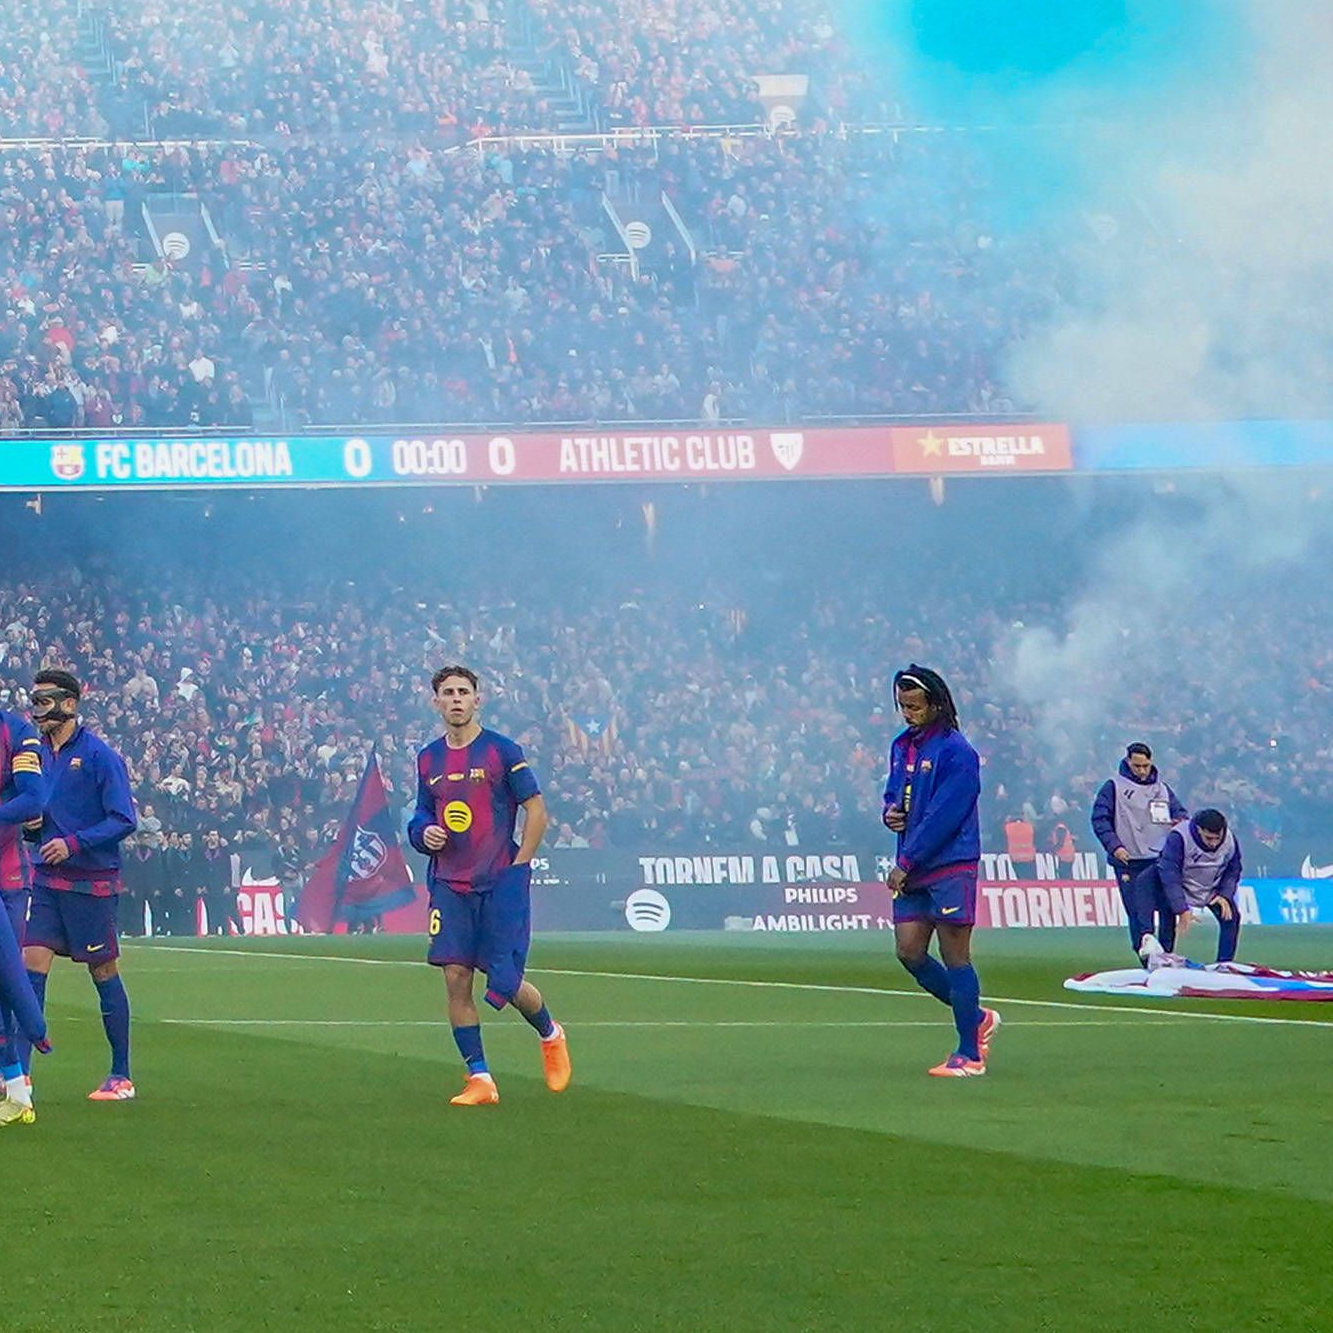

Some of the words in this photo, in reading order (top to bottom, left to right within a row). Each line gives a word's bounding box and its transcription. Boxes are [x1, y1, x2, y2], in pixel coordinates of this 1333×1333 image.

[948, 436, 1045, 456] ESTRELLA
[95, 443, 130, 479] FC
[134, 441, 293, 479] BARCELONA
[344, 439, 372, 477] 0
[392, 439, 467, 476] 00:00
[488, 437, 515, 475] 0
[559, 436, 682, 472] ATHLETIC
[685, 435, 757, 470] CLUB
[784, 888, 858, 903] PHILIPS
[752, 915, 871, 931] AMBILIGHT
